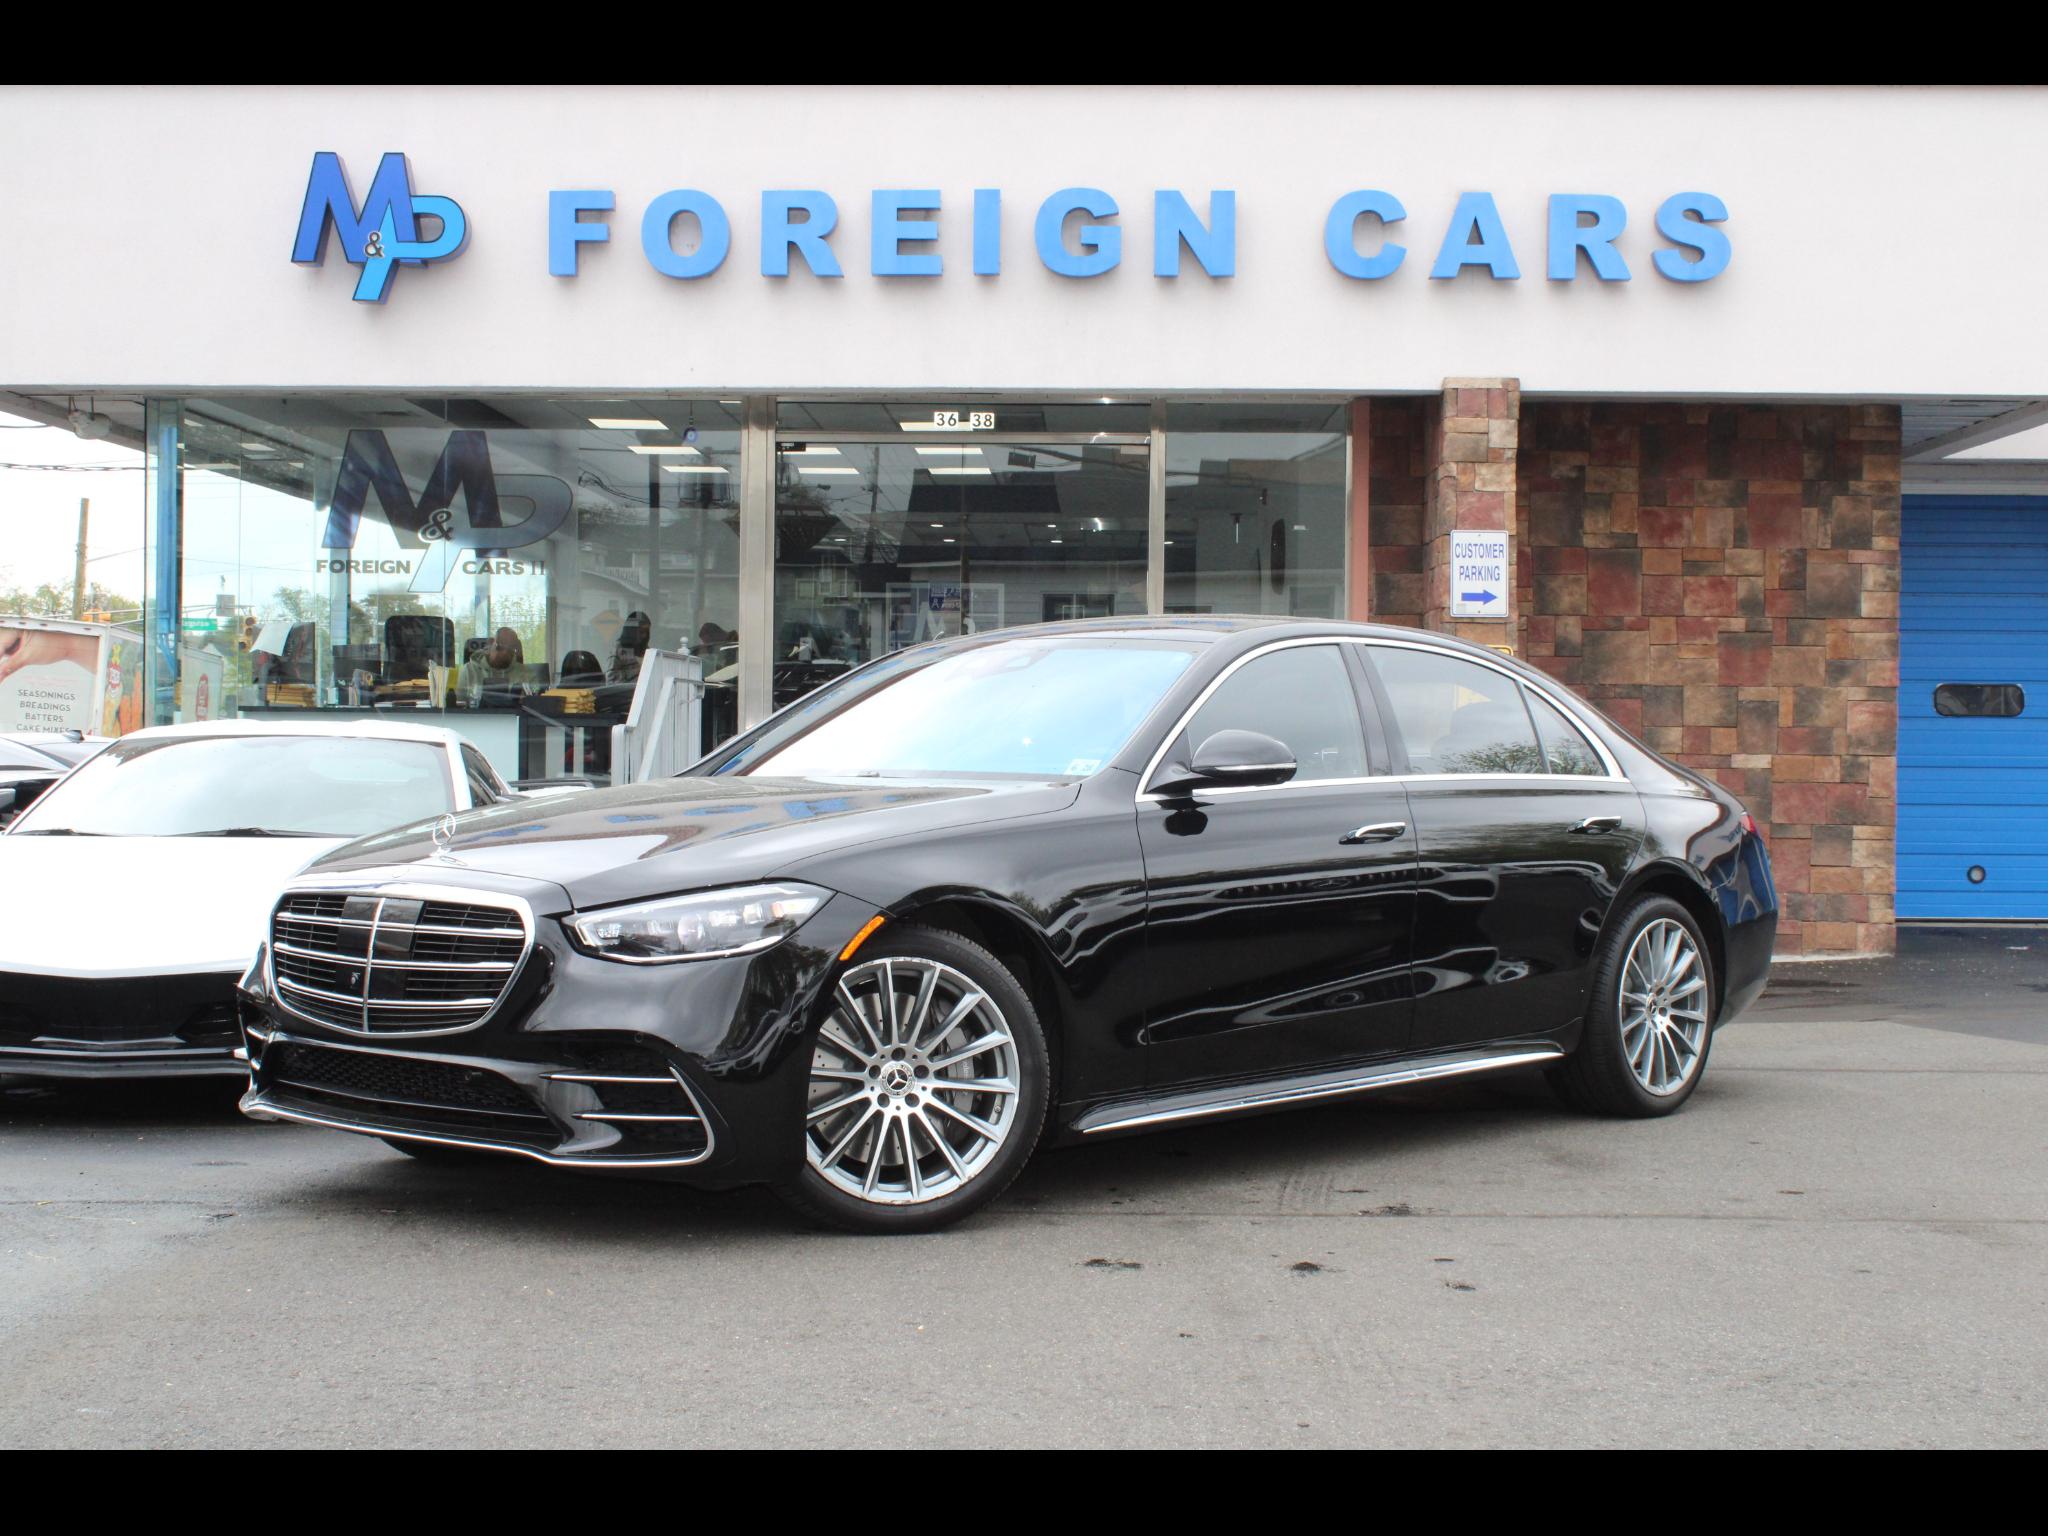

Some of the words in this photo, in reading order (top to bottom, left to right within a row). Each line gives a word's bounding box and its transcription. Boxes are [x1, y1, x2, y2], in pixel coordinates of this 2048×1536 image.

[548, 188, 1237, 281] FOREIGN
[1323, 188, 1733, 282] CARS
[936, 413, 957, 427] 36
[972, 414, 993, 428] 38
[1454, 543, 1505, 559] CUSTOMER
[315, 559, 411, 575] FOREIGN
[462, 560, 525, 576] CARS
[531, 561, 545, 575] II
[1459, 565, 1501, 582] PARKING
[17, 688, 77, 701] SEASONINGS
[19, 700, 72, 712] BREADINGS
[24, 712, 65, 723] BATTERS
[16, 723, 41, 733] CAKE
